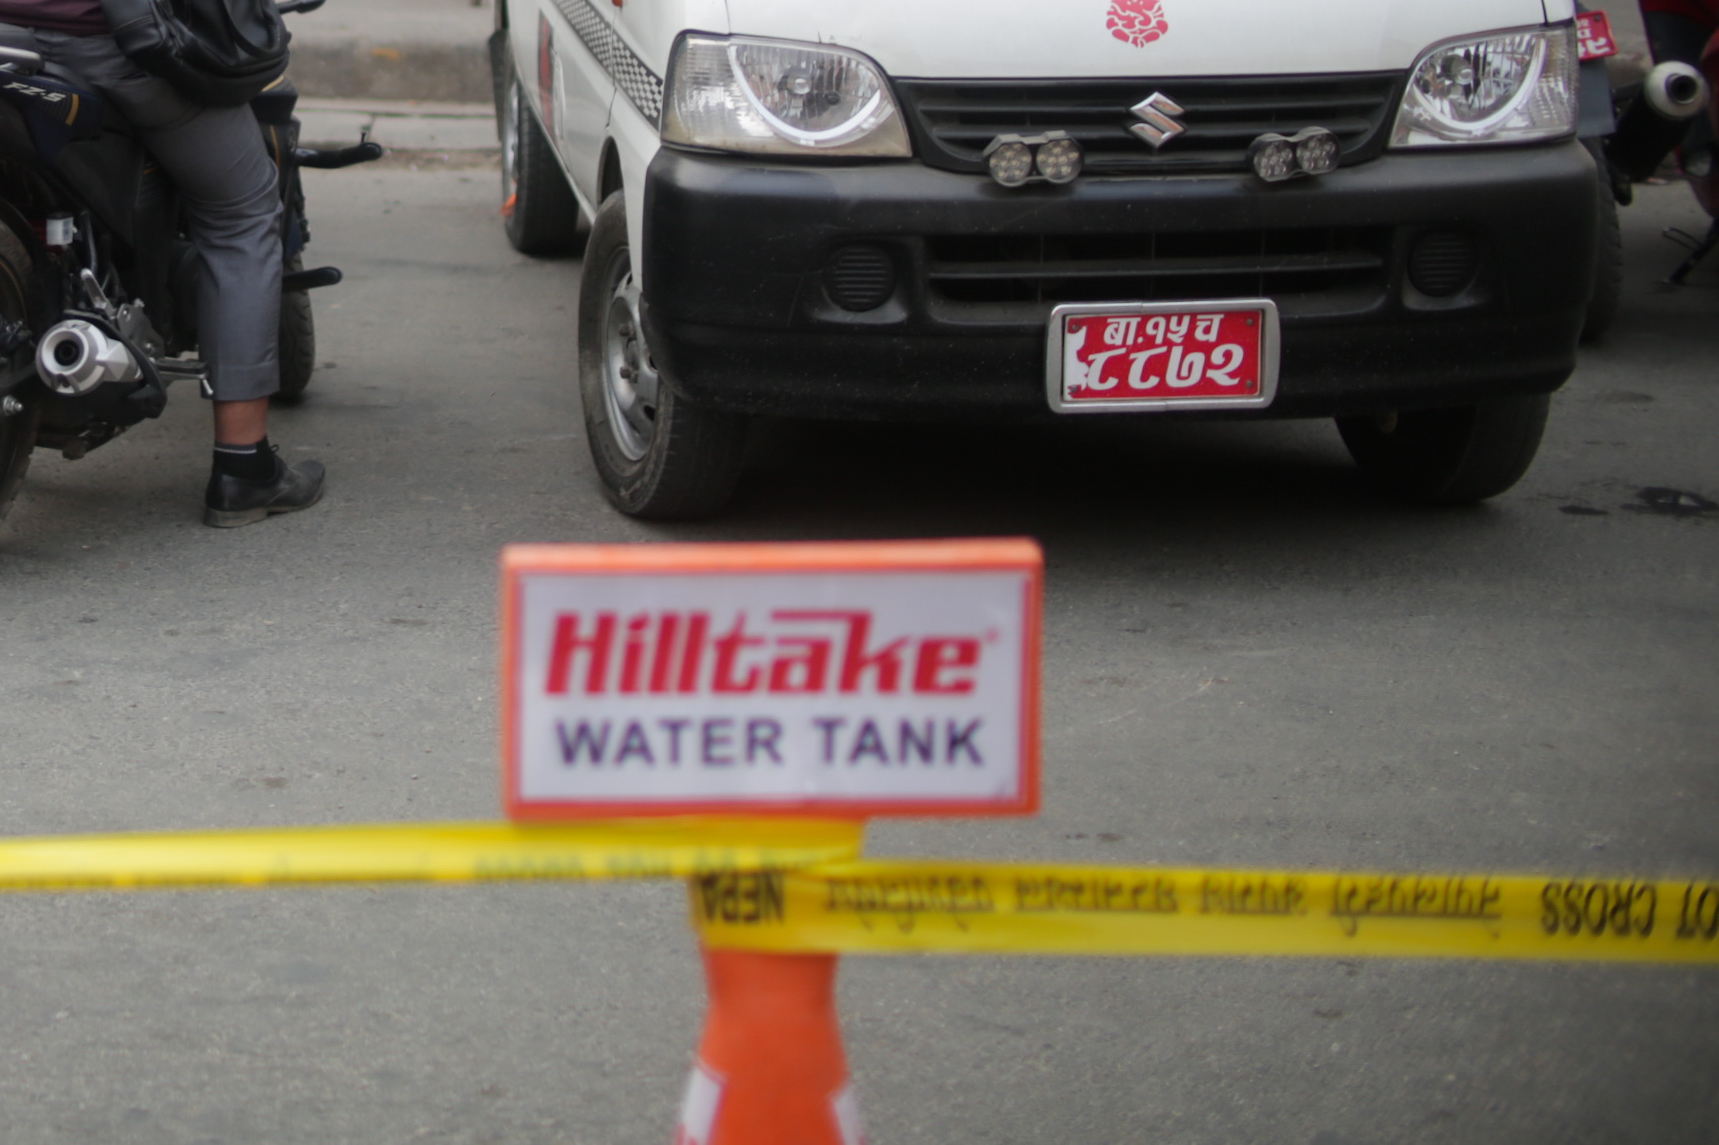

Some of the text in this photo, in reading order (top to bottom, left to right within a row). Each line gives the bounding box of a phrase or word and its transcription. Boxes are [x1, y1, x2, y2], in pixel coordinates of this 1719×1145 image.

[1087, 343, 1245, 391] ८८७२
[544, 609, 985, 697] Hilltake
[556, 717, 986, 768] WATER TANK
[1540, 881, 1658, 938] CROSS
